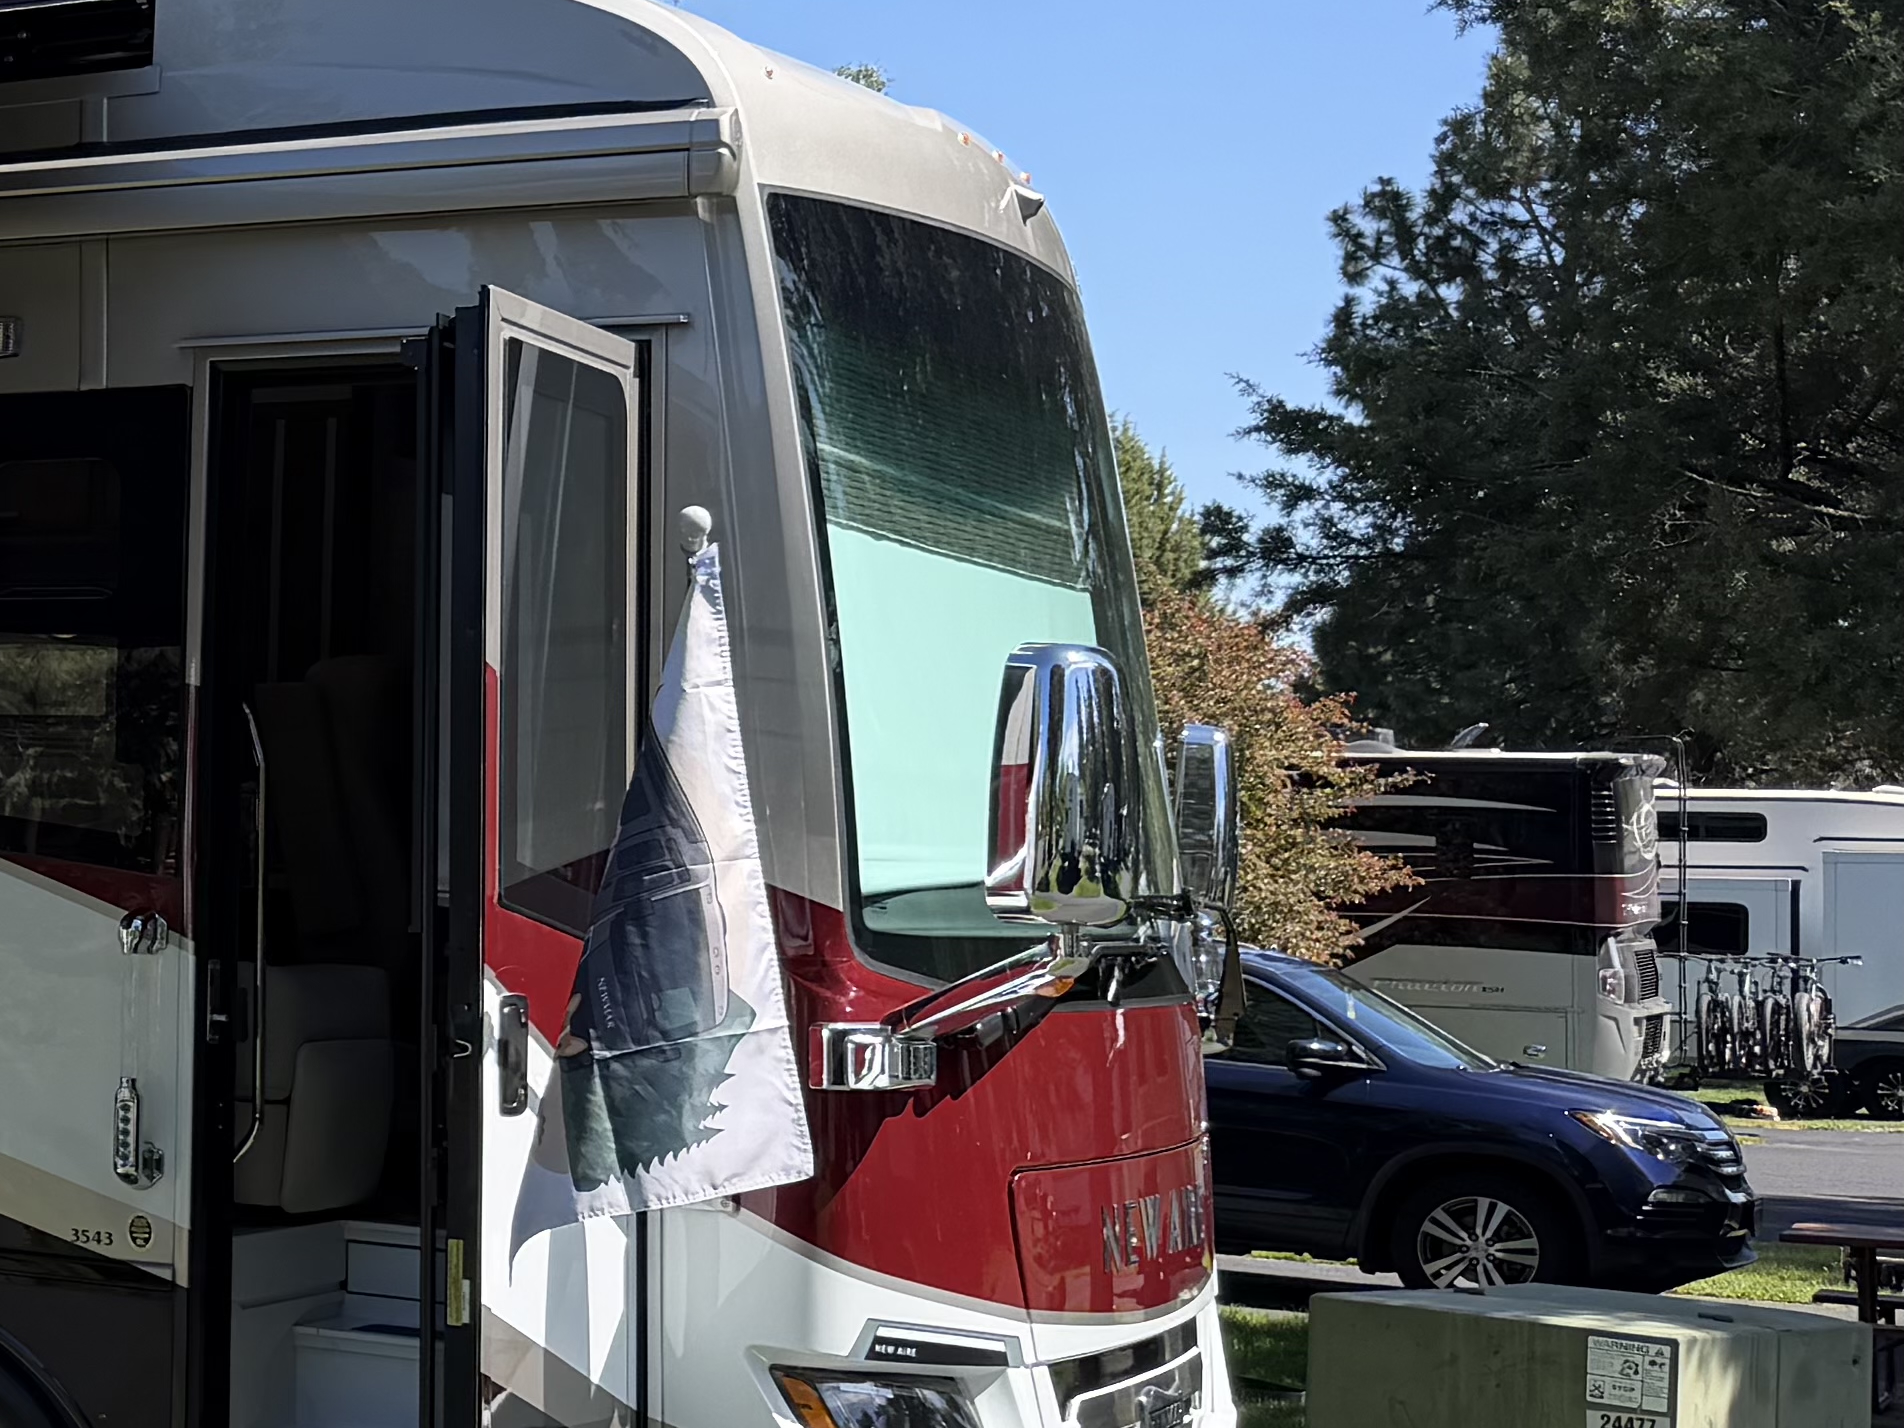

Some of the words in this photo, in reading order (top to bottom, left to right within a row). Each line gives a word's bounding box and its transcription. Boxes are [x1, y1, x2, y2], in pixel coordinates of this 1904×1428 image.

[70, 1227, 114, 1246] 3543
[1100, 1194, 1161, 1275] NEW
[875, 1344, 895, 1354] NEW
[897, 1347, 917, 1357] AIRE
[1592, 1339, 1651, 1355] WARNING
